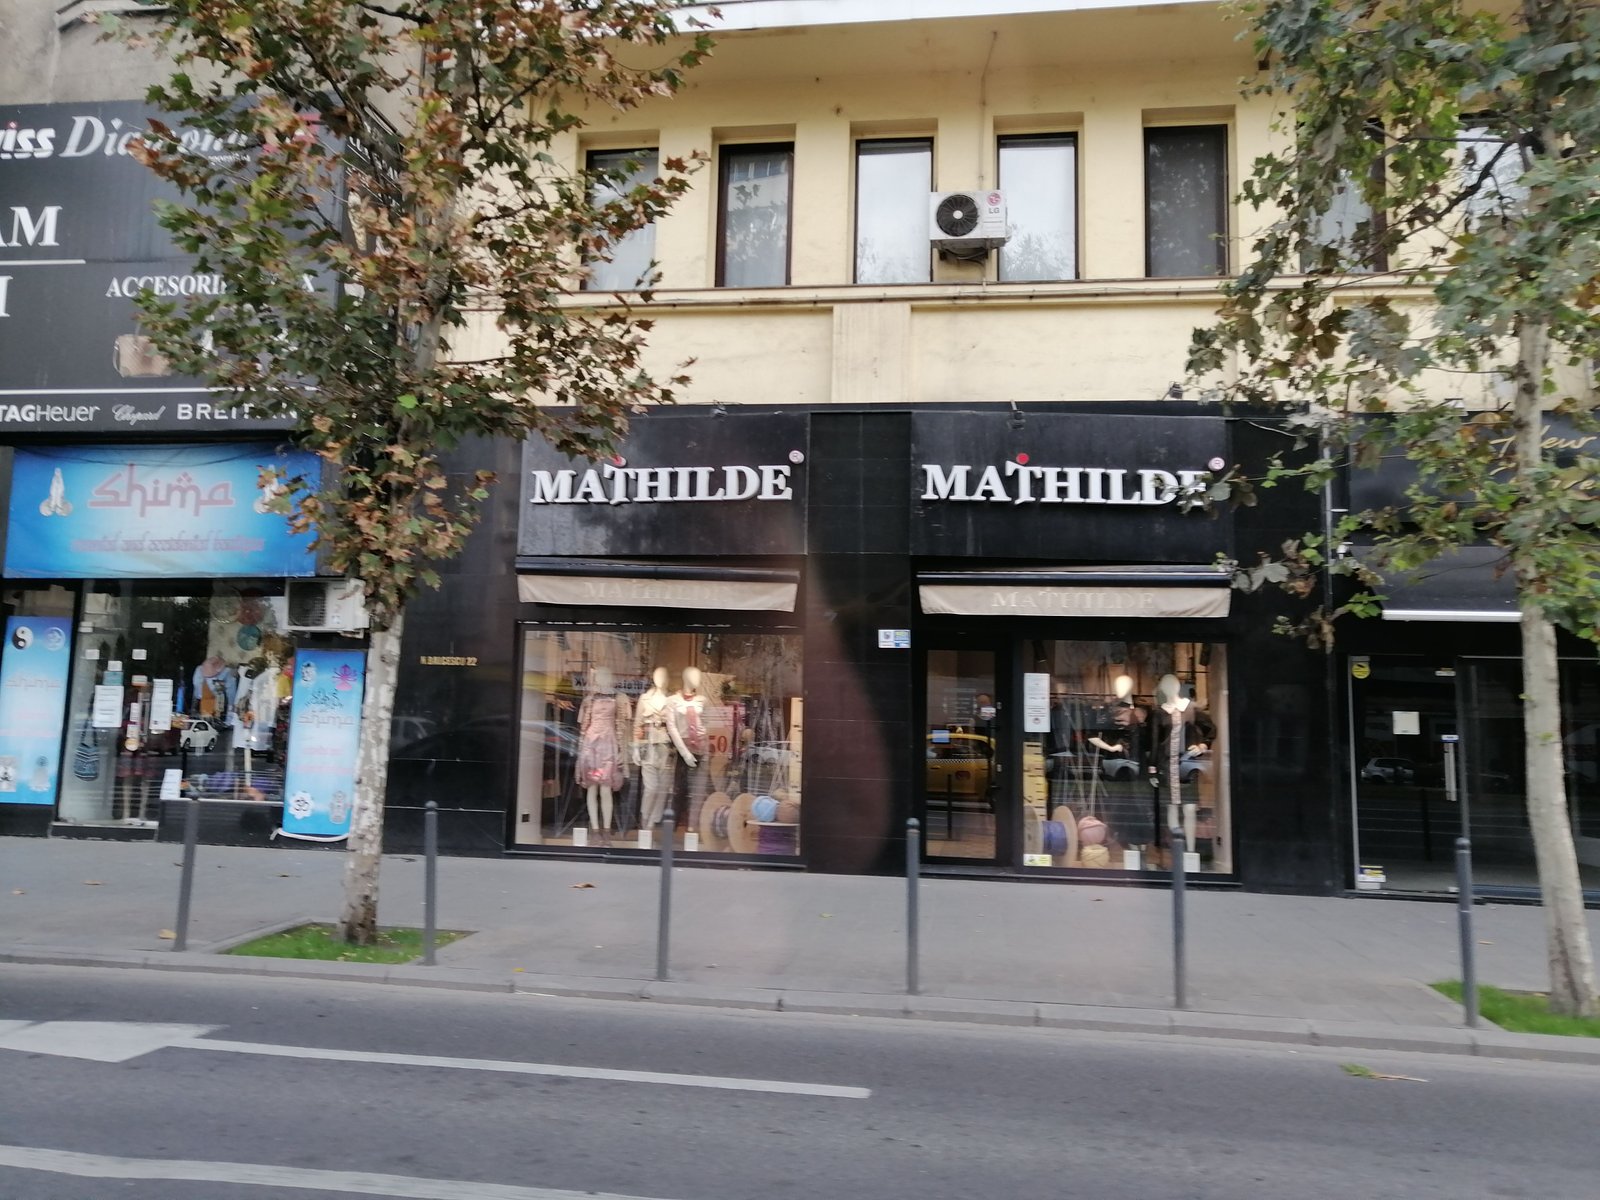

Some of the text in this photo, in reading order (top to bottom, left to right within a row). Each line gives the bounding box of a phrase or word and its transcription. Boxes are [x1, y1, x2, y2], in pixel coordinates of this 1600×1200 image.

[0, 121, 56, 160] iss
[530, 463, 793, 504] MATHILDE
[920, 460, 1212, 505] MATHILDE
